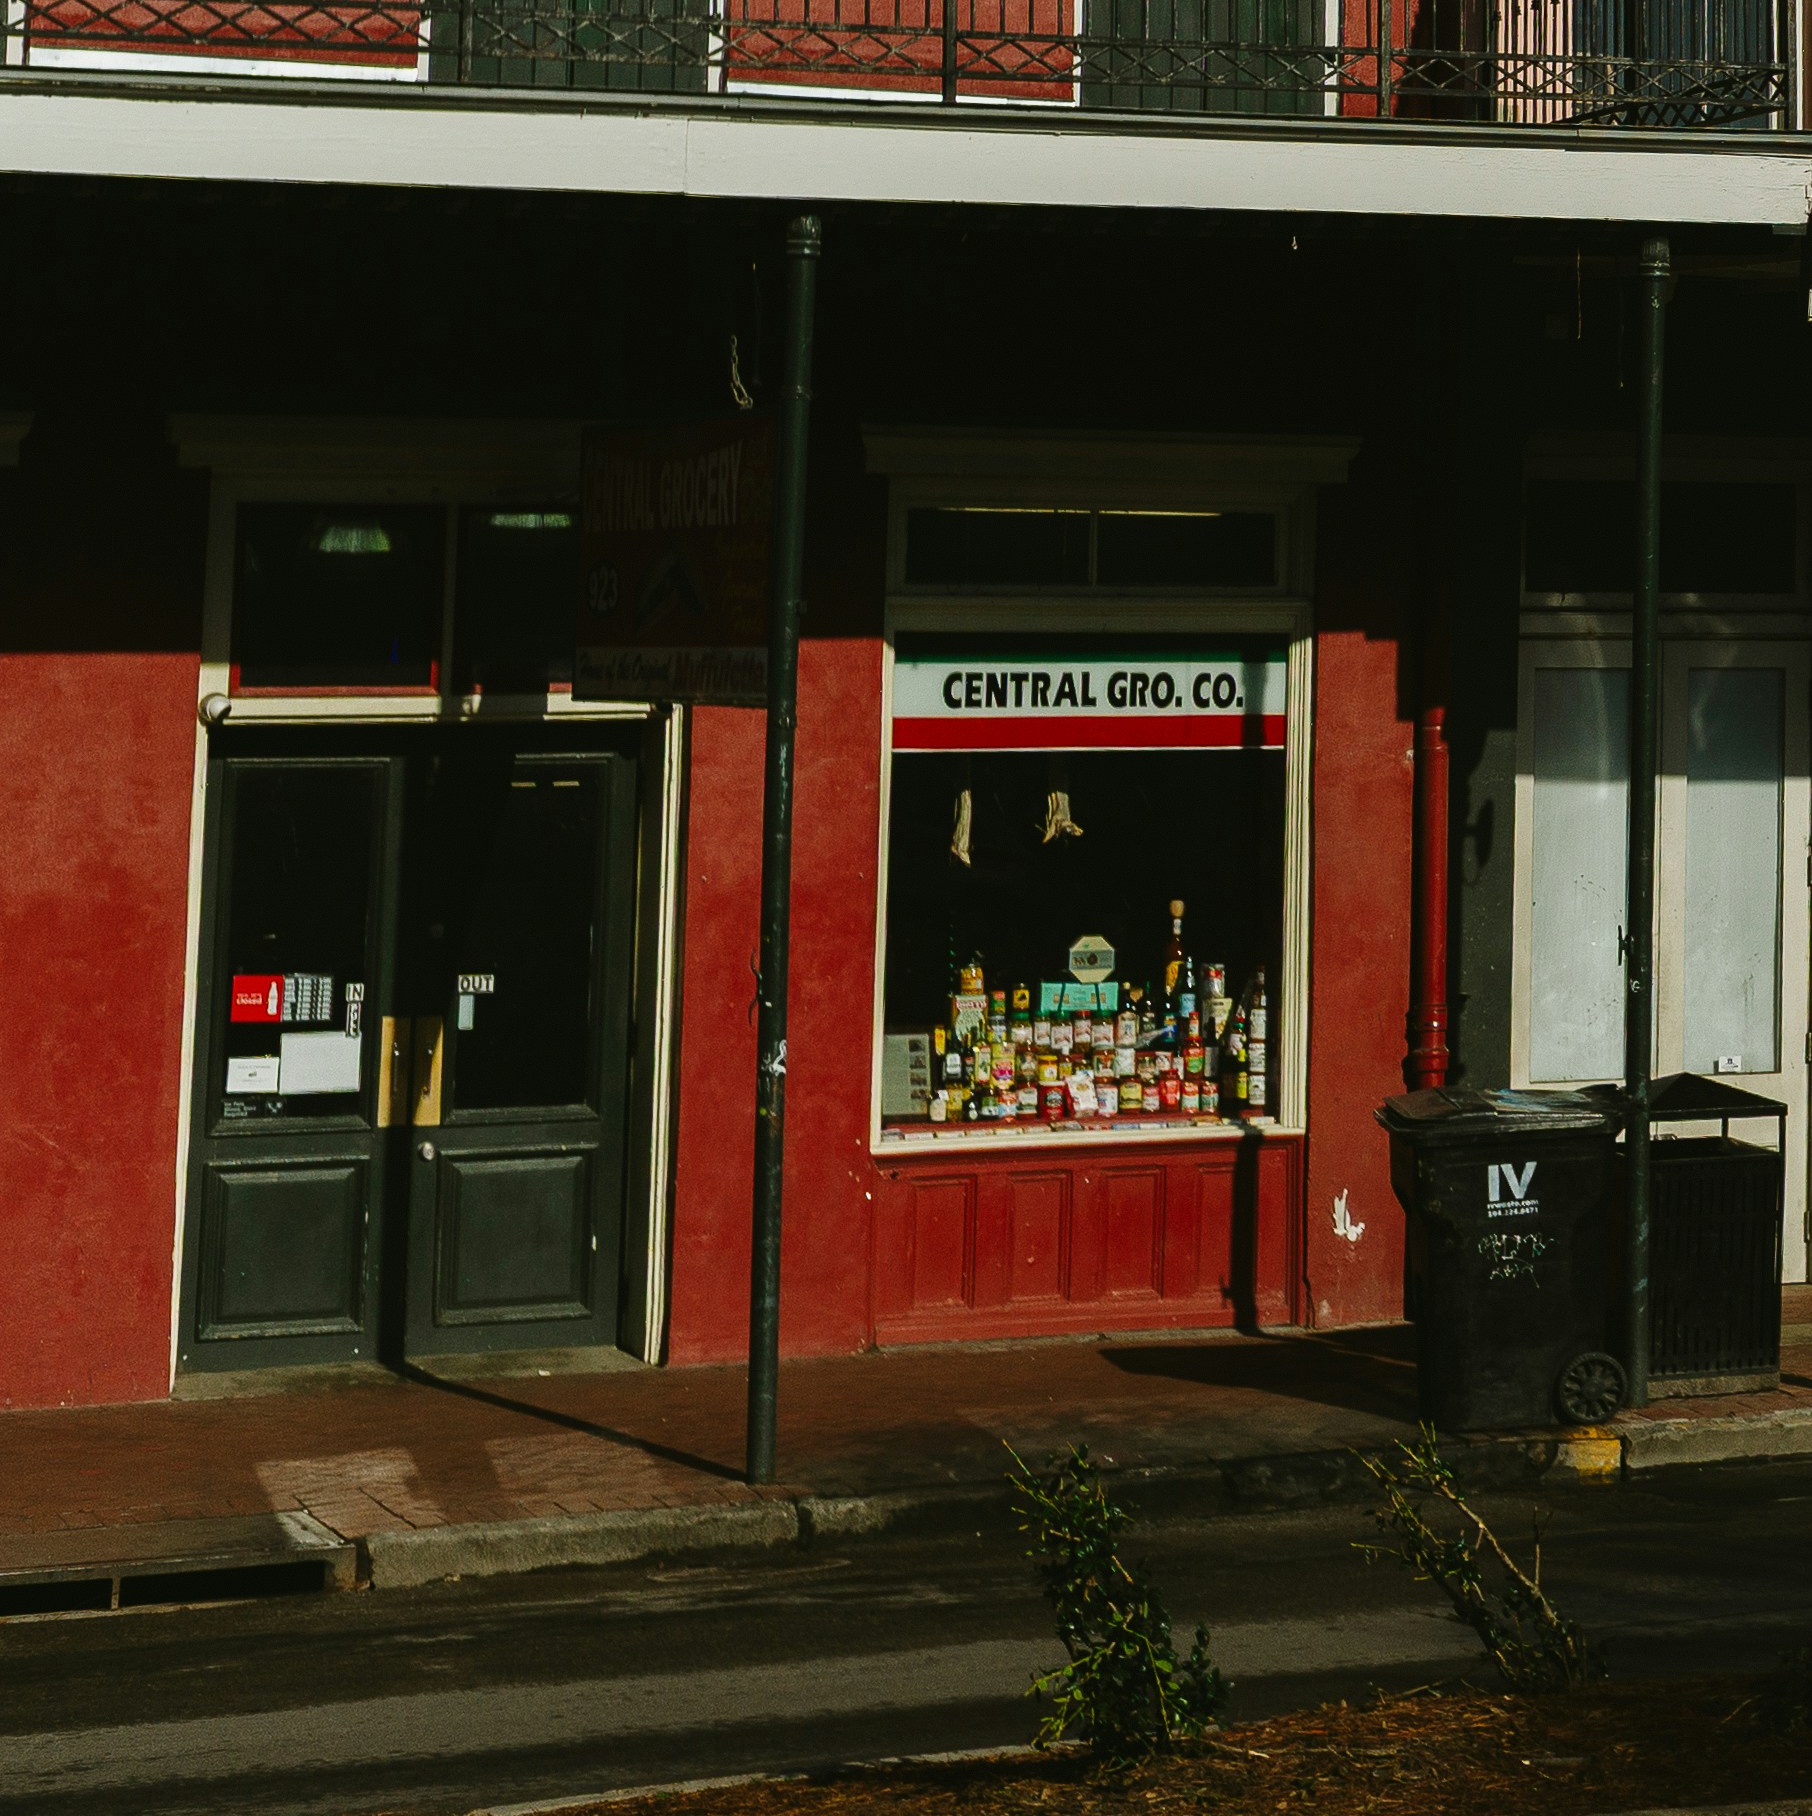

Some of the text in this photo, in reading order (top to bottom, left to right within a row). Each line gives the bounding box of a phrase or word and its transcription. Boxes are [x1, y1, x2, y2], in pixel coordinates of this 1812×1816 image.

[659, 439, 743, 529] GROCERY
[588, 564, 618, 612] 923
[942, 671, 1245, 709] CENTRAL GRO. CO.
[348, 983, 363, 1001] IN
[460, 975, 493, 993] OUT
[1487, 1160, 1538, 1202] IV
